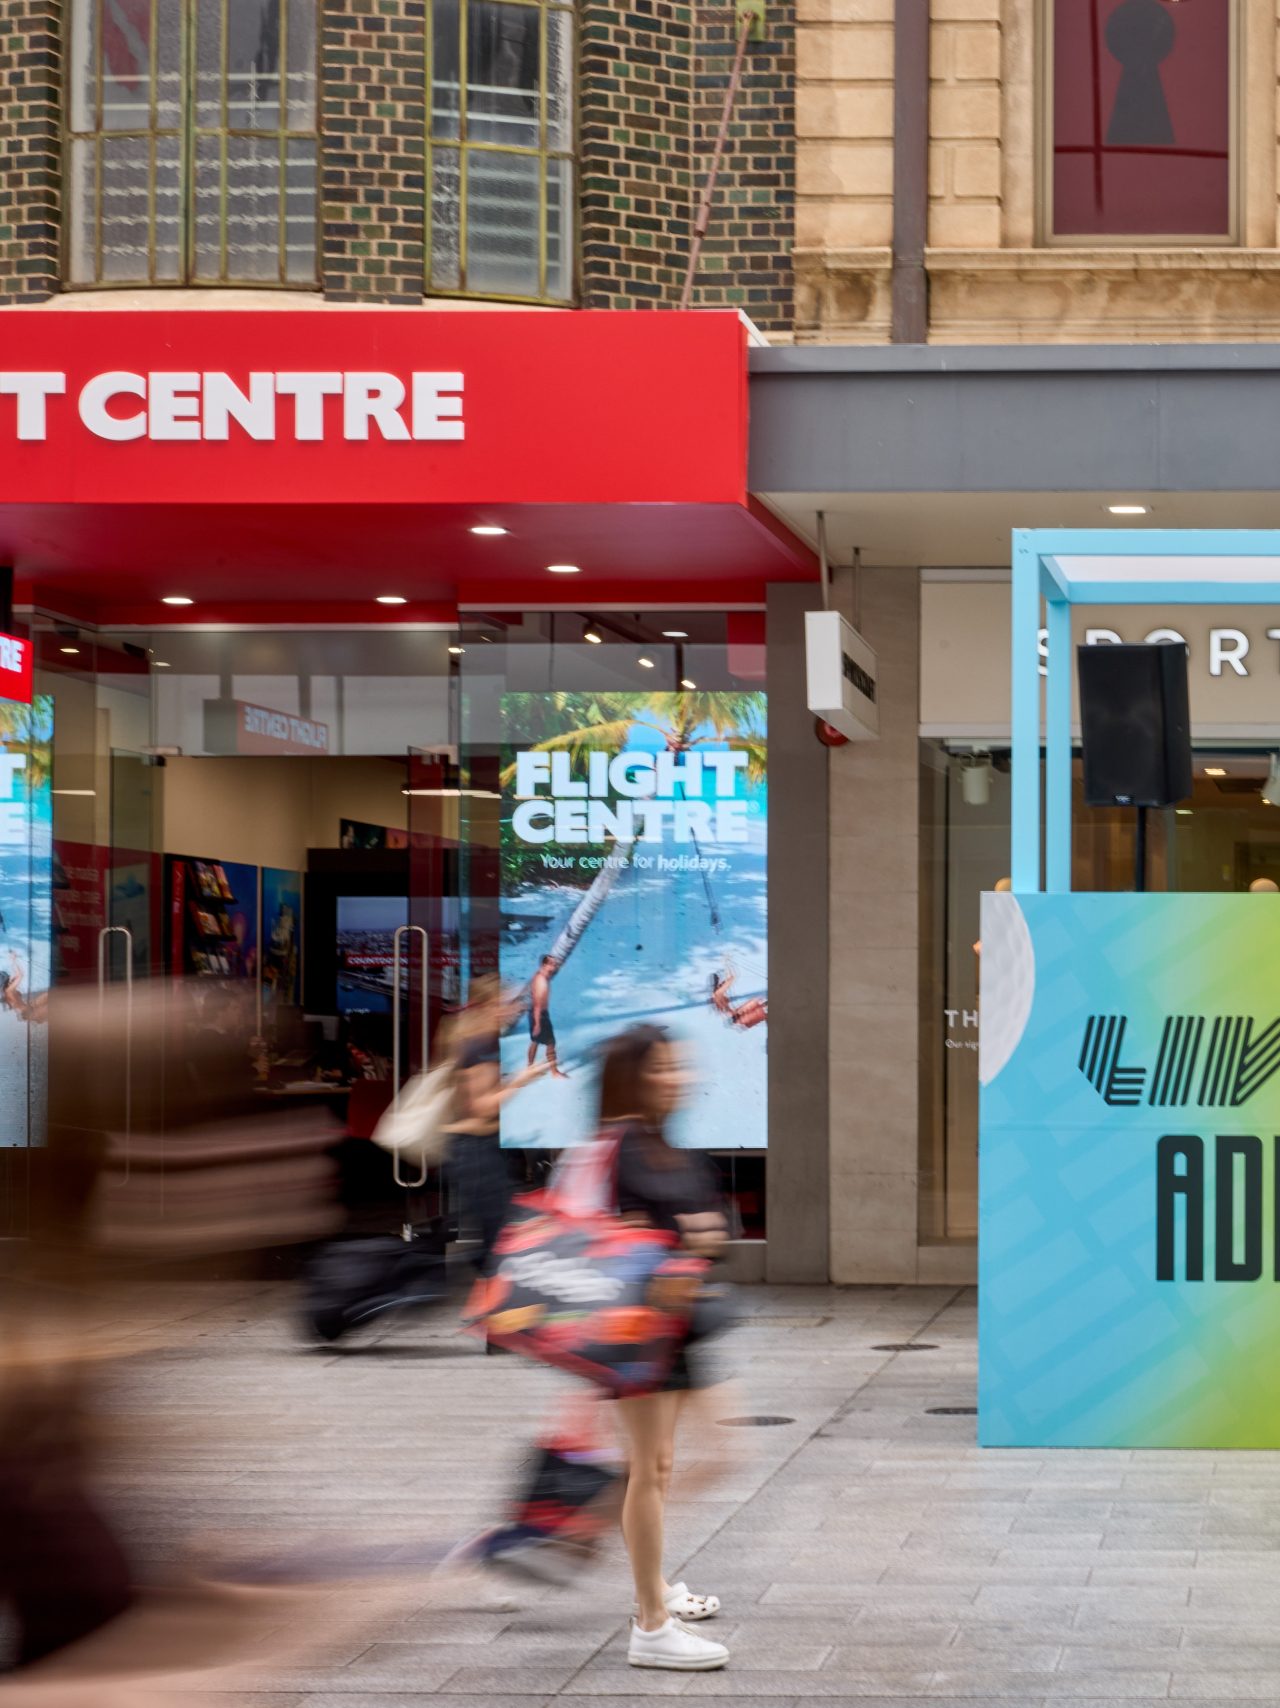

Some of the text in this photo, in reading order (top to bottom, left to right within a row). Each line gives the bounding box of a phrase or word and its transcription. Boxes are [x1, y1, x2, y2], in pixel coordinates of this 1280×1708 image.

[79, 371, 465, 440] CENTRE
[515, 751, 749, 798] FLIGHT
[512, 800, 748, 843] CENTRE
[540, 853, 732, 872] Your centre for holidays.
